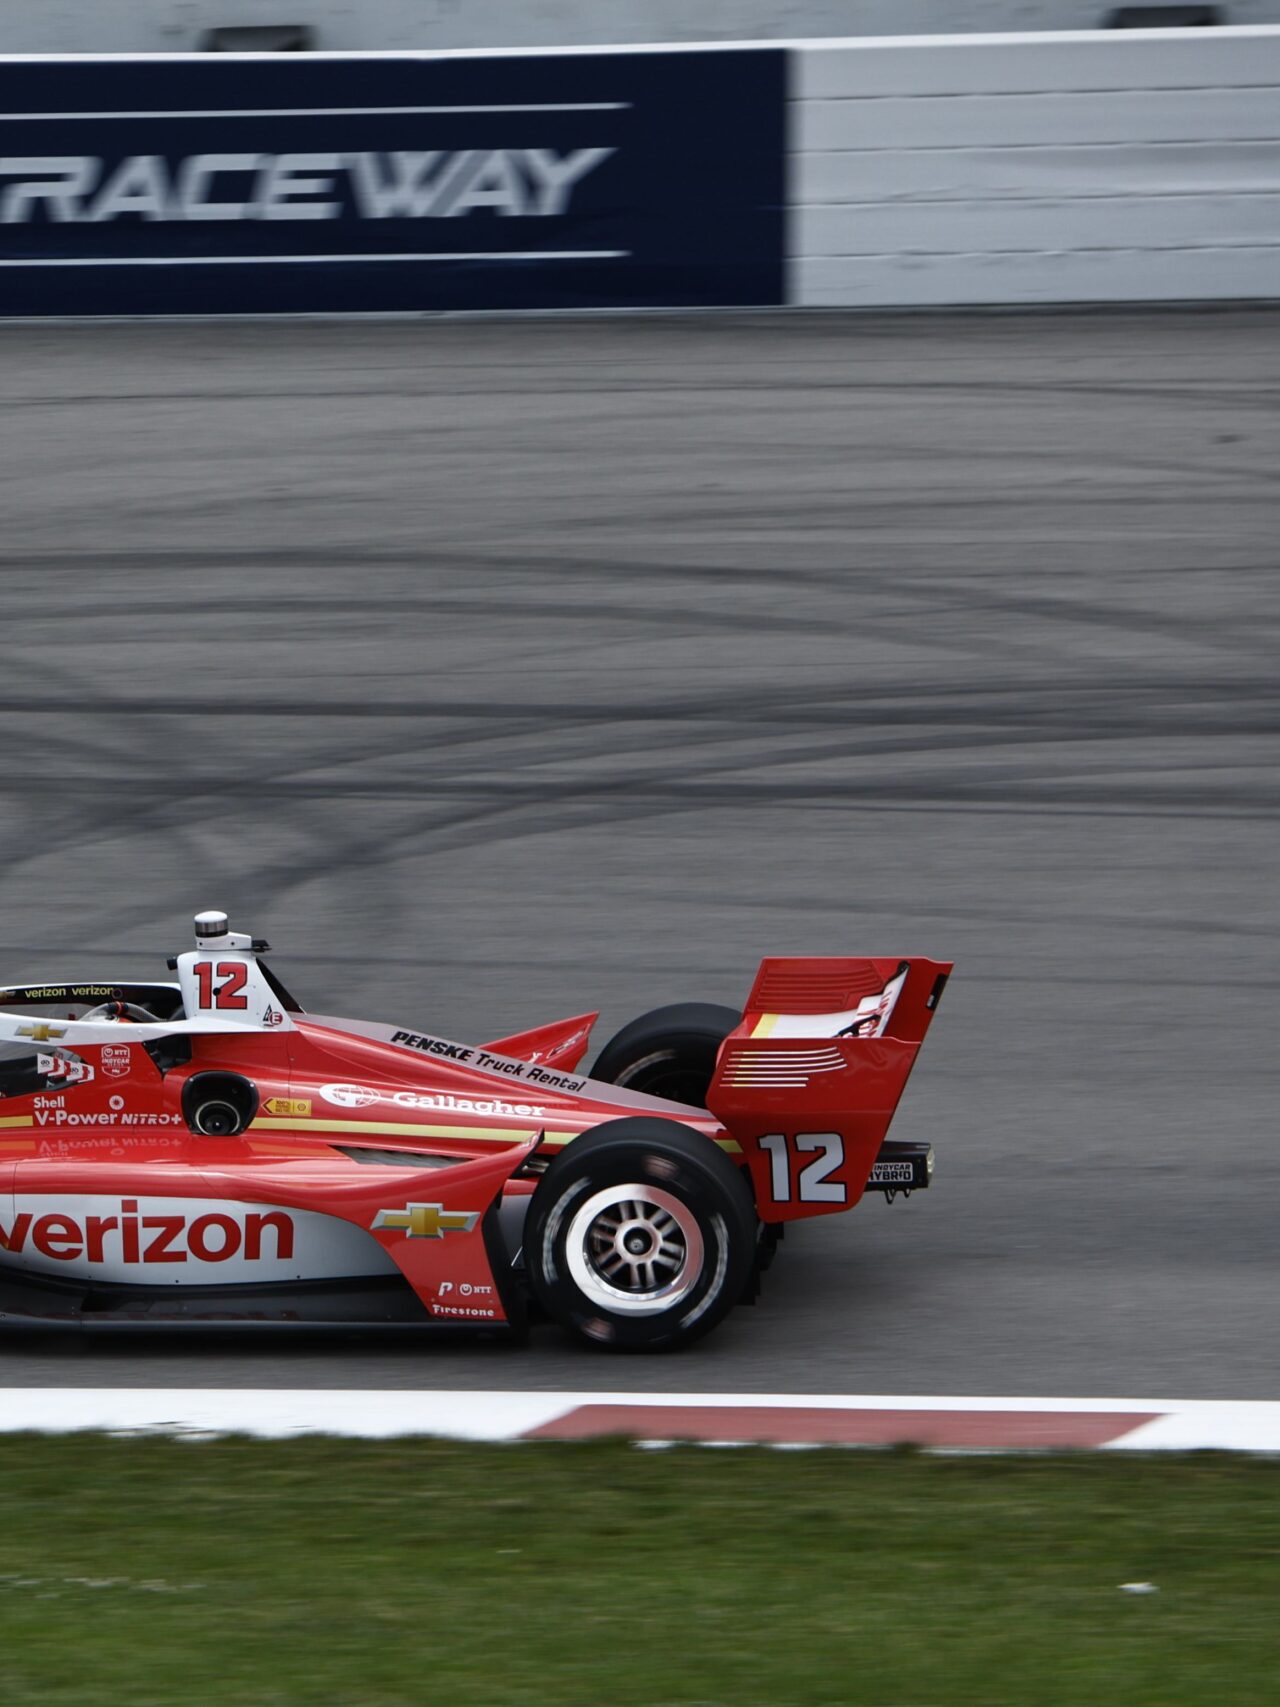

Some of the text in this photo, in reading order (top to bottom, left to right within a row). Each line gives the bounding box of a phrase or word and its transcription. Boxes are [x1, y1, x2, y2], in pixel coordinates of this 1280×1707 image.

[25, 987, 66, 998] verizon
[193, 961, 248, 1009] 12
[390, 1031, 475, 1062] PENSKE
[475, 1053, 526, 1076] Truck
[526, 1068, 587, 1093] Rental
[33, 1096, 65, 1109] Shell
[393, 1092, 546, 1116] Gallagher
[34, 1110, 117, 1126] V-Power
[757, 1132, 847, 1204] 12
[473, 1286, 492, 1294] NTT
[432, 1304, 494, 1317] Firestone
